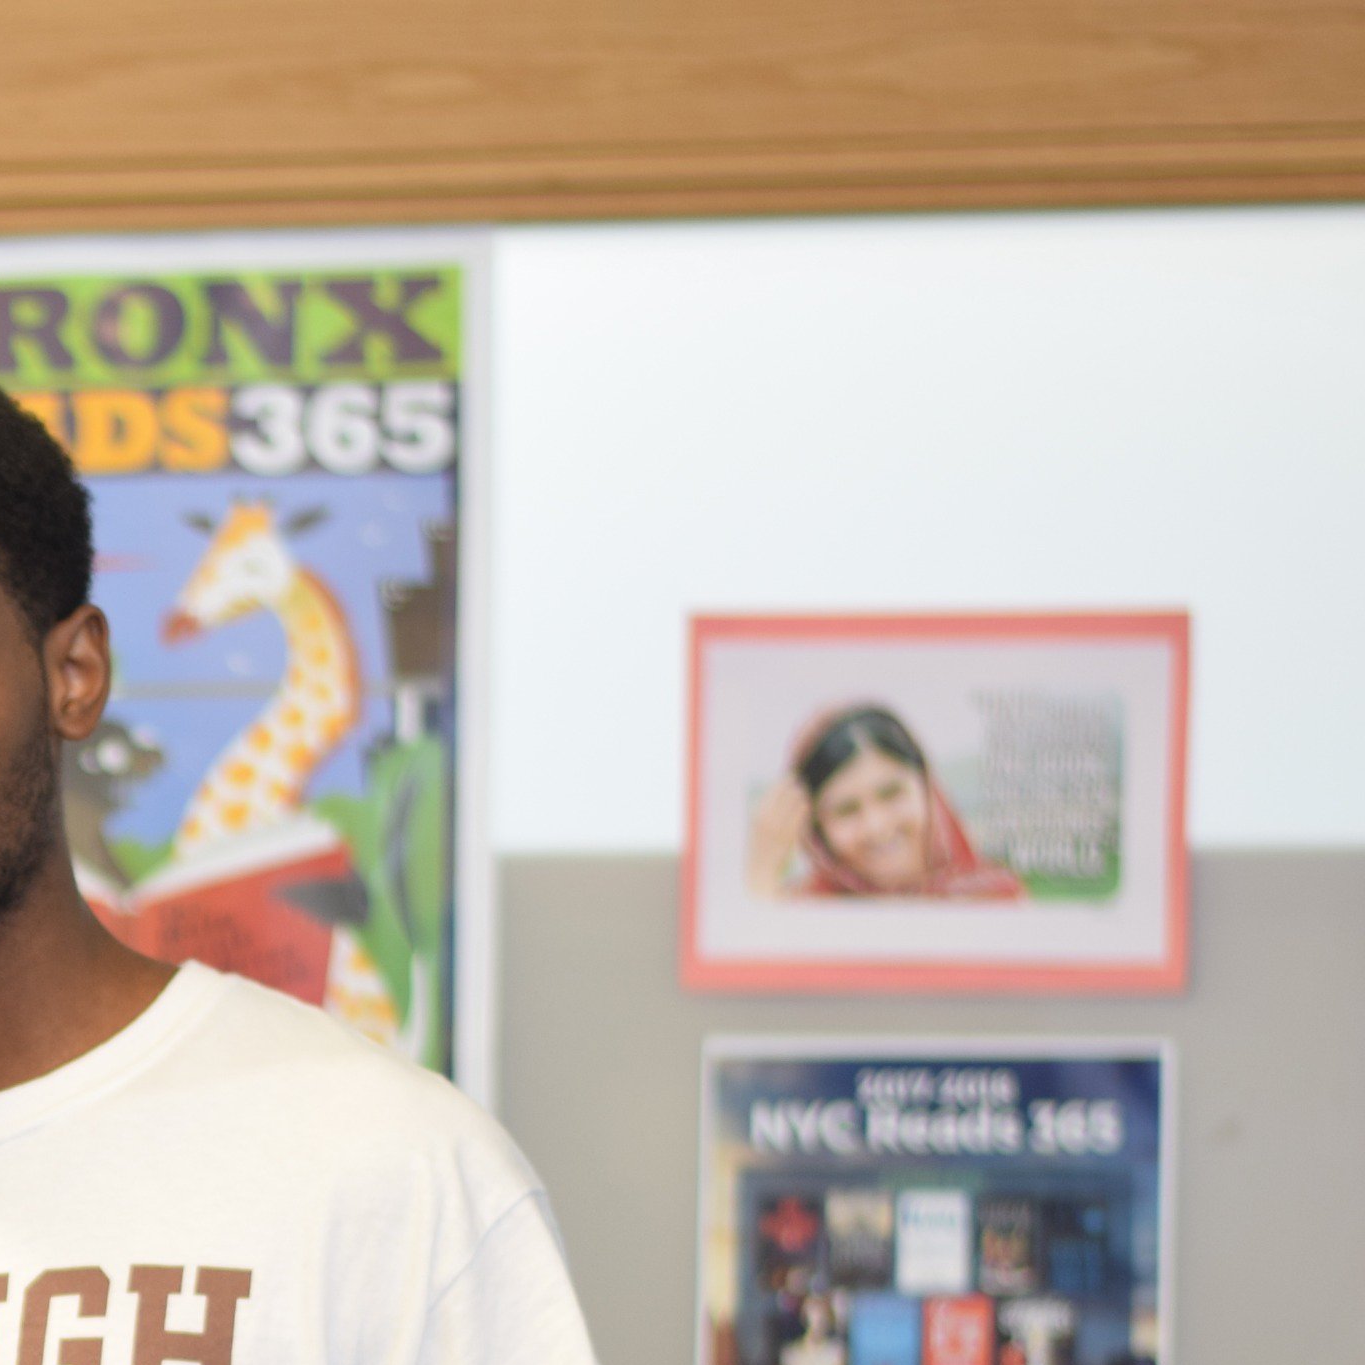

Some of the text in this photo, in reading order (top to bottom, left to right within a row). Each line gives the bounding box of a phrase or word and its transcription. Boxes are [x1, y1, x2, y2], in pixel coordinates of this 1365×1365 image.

[749, 1097, 1126, 1156] NYC Reads 365
